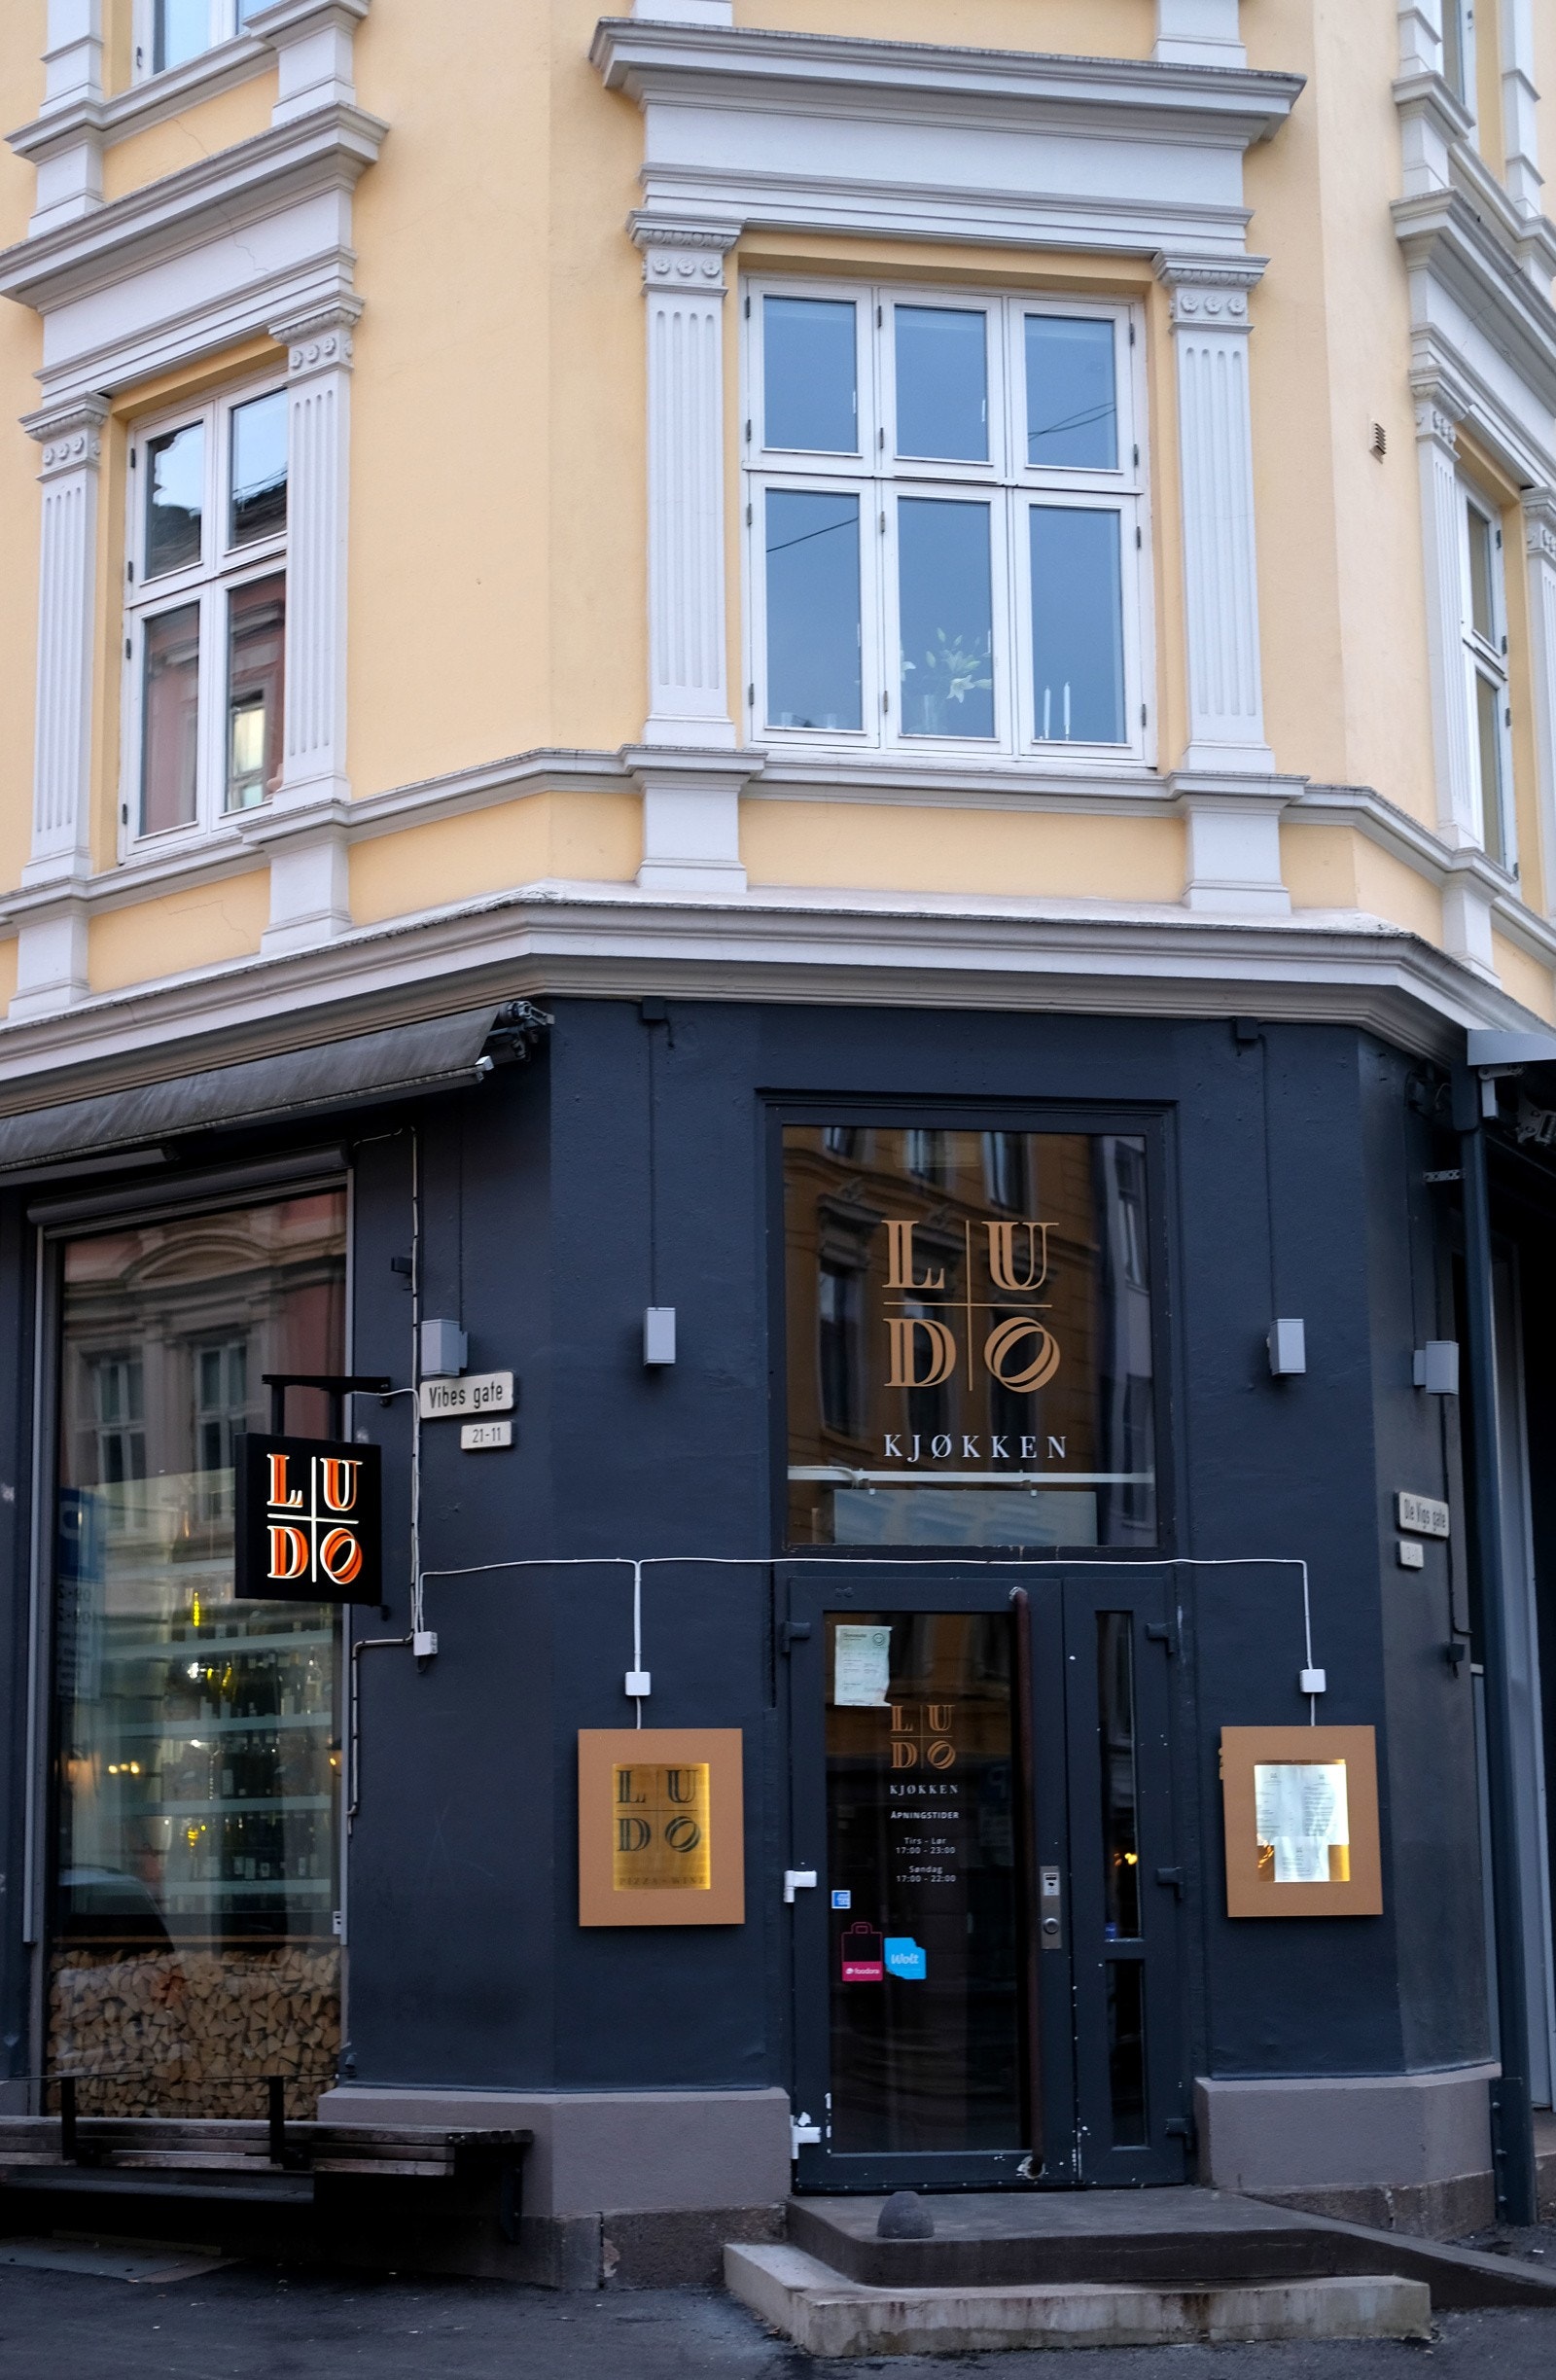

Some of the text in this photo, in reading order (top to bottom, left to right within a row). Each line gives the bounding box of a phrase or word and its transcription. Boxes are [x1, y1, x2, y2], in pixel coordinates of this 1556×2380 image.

[429, 1380, 504, 1410] Vibes gate
[472, 1427, 502, 1443] 21-11
[883, 1433, 1067, 1463] KJØKKEN
[889, 1784, 960, 1796] KJØKKEN
[890, 1810, 960, 1820] ÅPNINGSTIDER
[903, 1836, 923, 1845] Tirs
[931, 1836, 946, 1845] Lør
[908, 1865, 943, 1875] Søndag
[619, 1876, 658, 1886] PIZZA
[891, 1953, 919, 1965] Wolt
